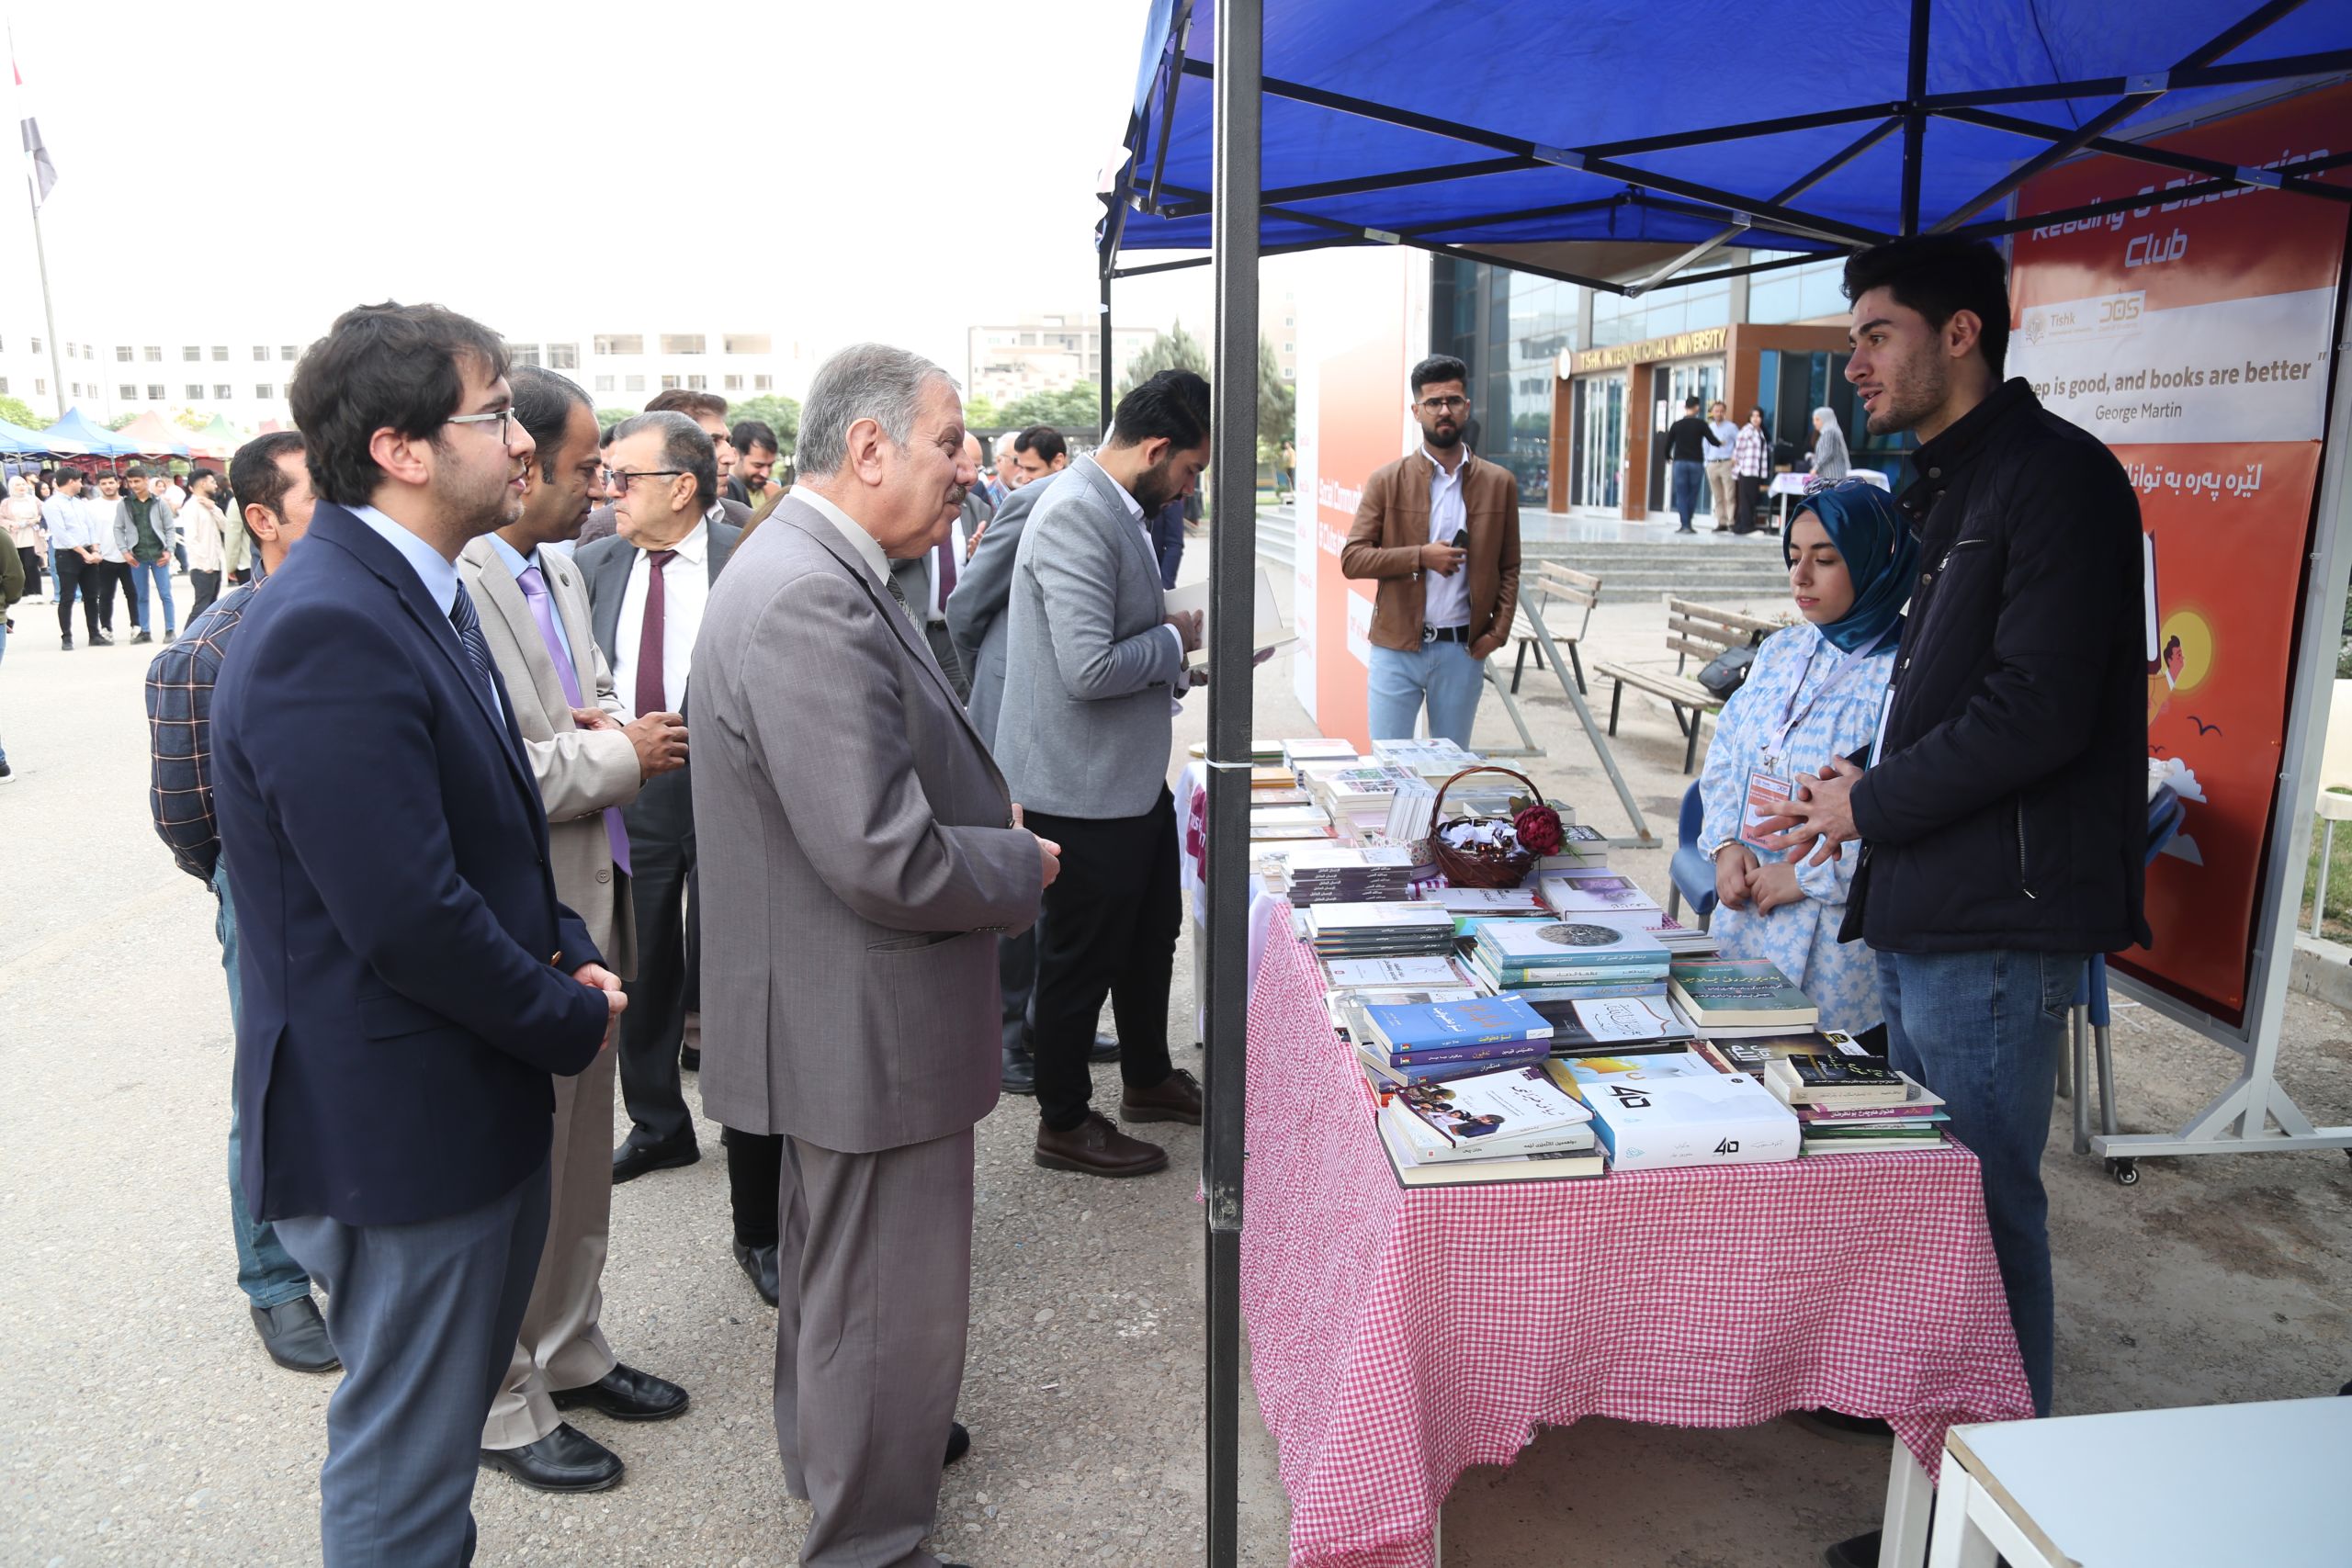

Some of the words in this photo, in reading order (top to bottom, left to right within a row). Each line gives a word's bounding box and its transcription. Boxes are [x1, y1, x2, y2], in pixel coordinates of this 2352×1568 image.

[2125, 228, 2188, 267] Club
[2050, 311, 2076, 327] Tishk
[1581, 351, 1602, 370] TISHK
[1604, 339, 1668, 367] INTERNATIONAL
[1671, 327, 1728, 356] UNIVERSITY
[2053, 377, 2066, 396] is
[2068, 373, 2111, 400] good,
[2115, 369, 2146, 391] and
[2150, 366, 2204, 389] books
[2209, 368, 2239, 386] are
[2245, 360, 2312, 383] better
[2096, 404, 2138, 423] George
[2142, 401, 2183, 420] Martin
[1713, 1136, 1739, 1156] 40
